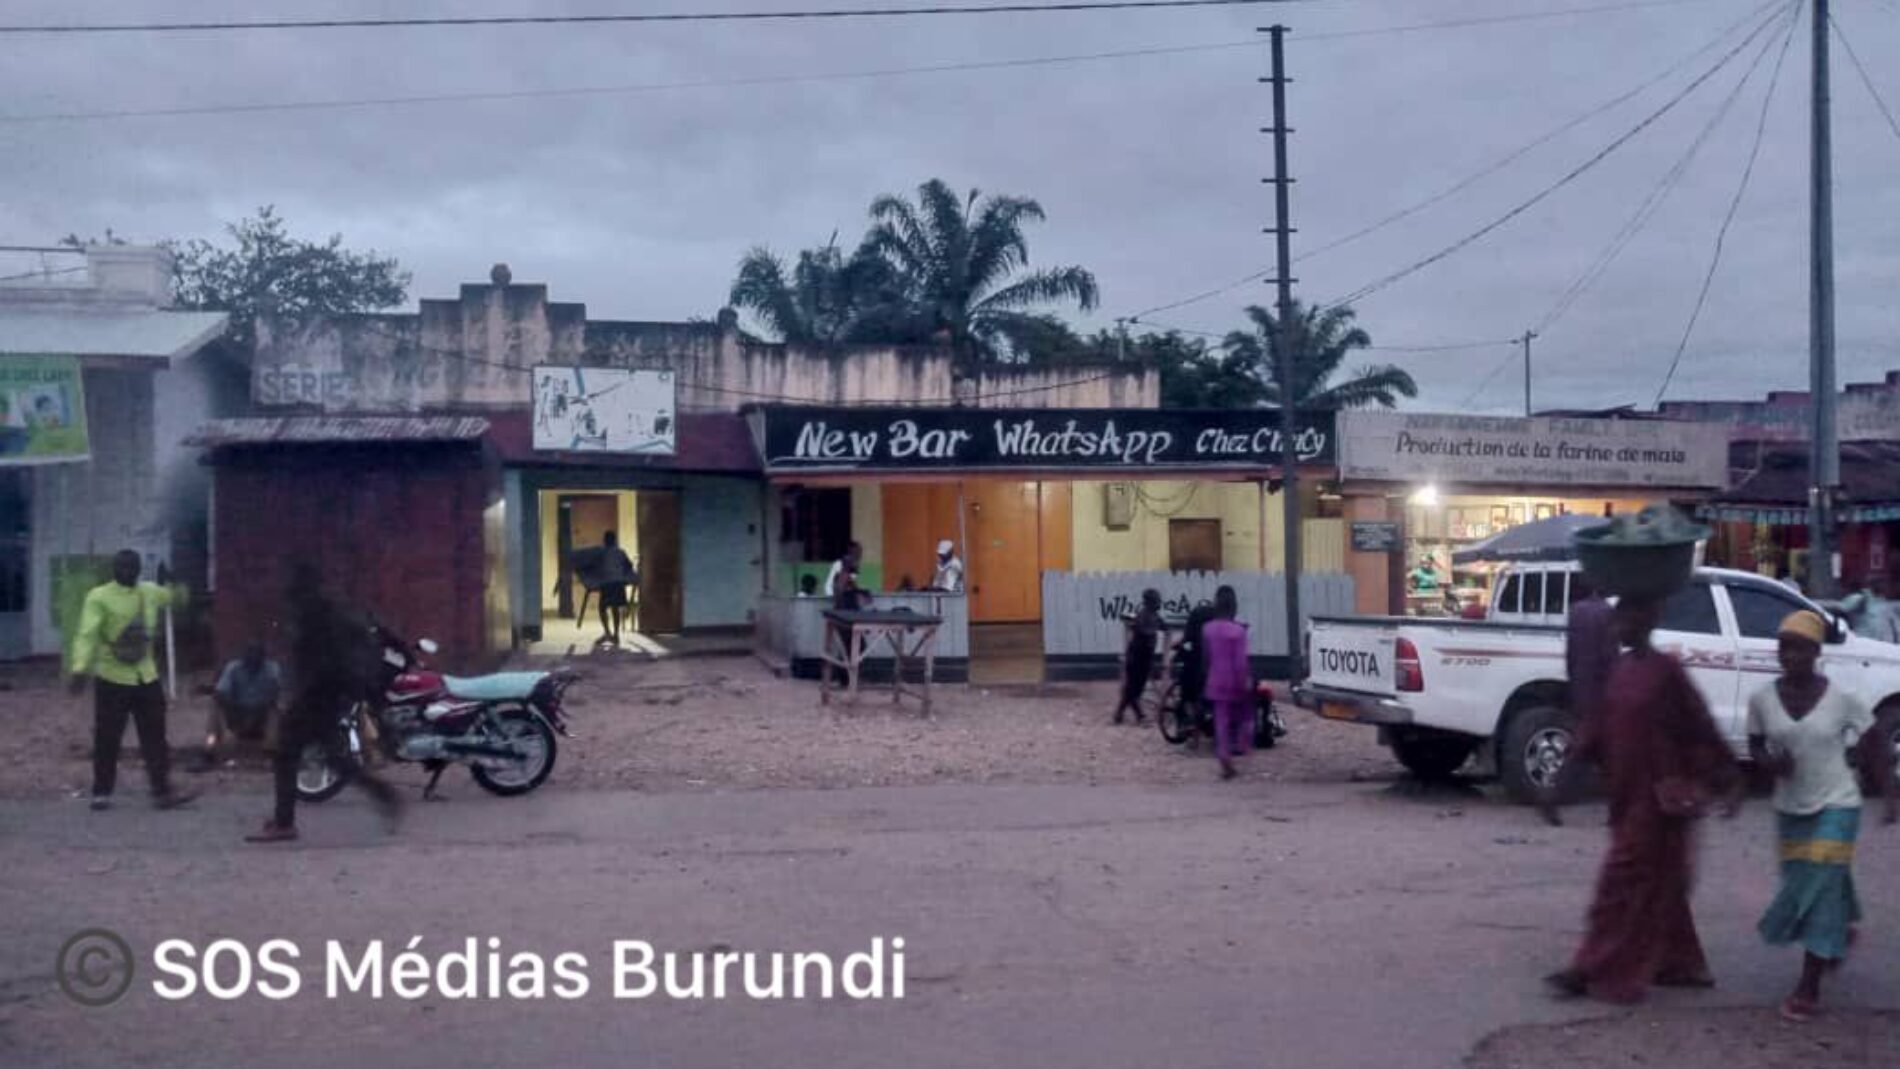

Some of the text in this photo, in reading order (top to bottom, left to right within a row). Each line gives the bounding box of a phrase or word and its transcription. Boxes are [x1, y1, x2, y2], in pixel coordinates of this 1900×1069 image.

[795, 421, 878, 458] New
[888, 419, 973, 458] Bar
[994, 419, 1172, 463] WhatsApp
[1196, 428, 1249, 452] Chez
[1319, 648, 1380, 677] TOYOTA
